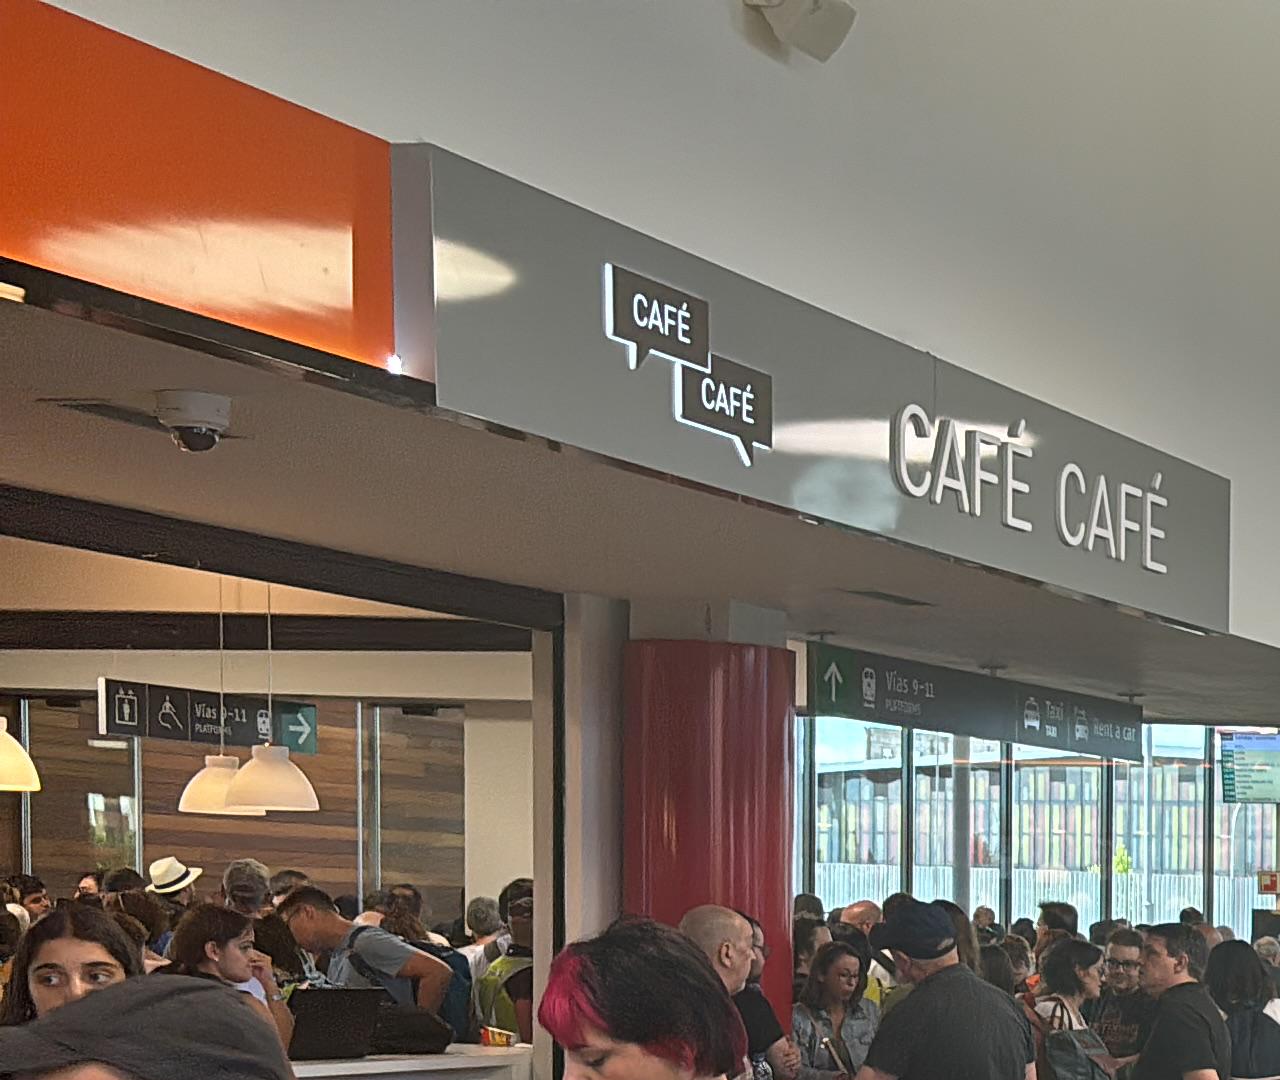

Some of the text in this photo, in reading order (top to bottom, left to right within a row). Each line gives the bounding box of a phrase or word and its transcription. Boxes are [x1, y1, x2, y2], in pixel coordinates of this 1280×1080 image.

[632, 292, 692, 346] CAFÉ
[700, 376, 756, 425] CAFÉ
[890, 403, 1169, 575] CAFÉ CAFÉ
[884, 669, 936, 699] Vías 9-11
